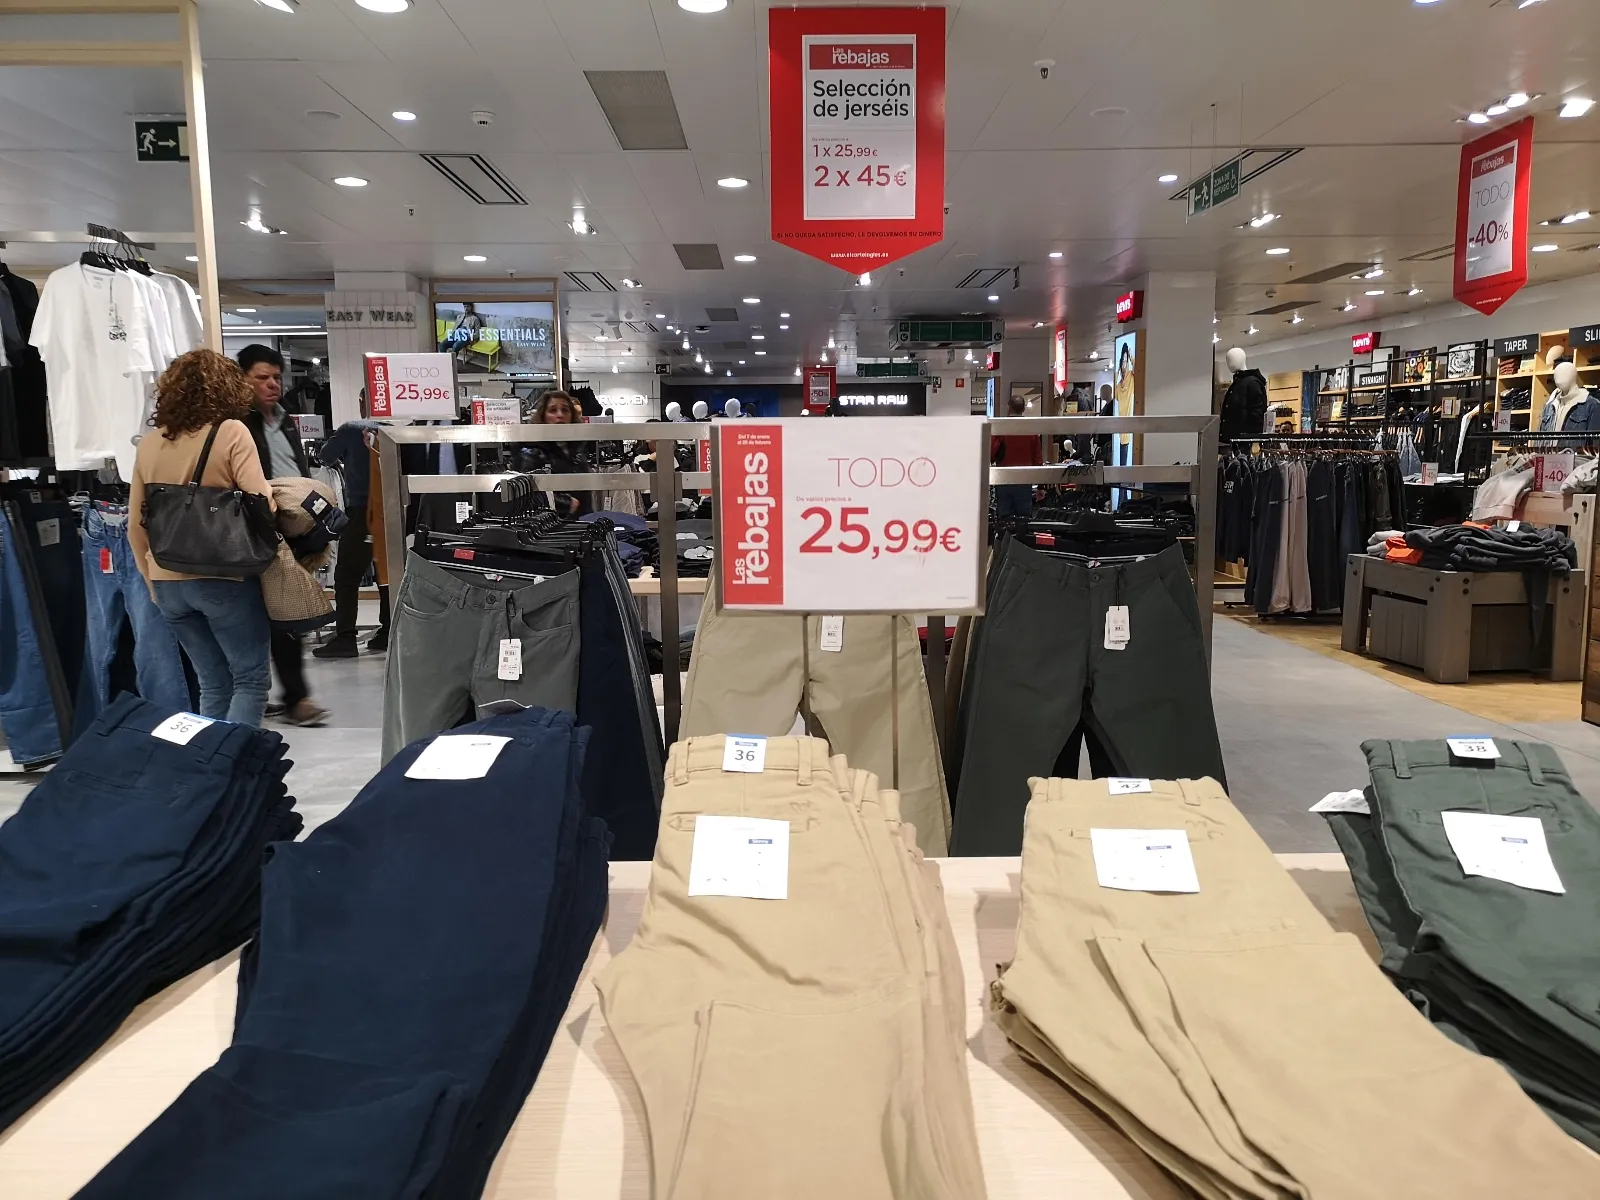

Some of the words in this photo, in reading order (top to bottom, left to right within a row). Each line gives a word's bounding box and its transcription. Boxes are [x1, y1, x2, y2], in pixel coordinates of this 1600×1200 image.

[832, 49, 889, 67] rebajas
[813, 78, 910, 97] Selección
[813, 99, 839, 117] de
[844, 98, 909, 120] jerséis
[813, 144, 819, 157] 1
[823, 147, 831, 157] x
[834, 144, 878, 159] 25,99€
[814, 165, 829, 187] 2
[836, 170, 850, 187] x
[857, 165, 907, 187] 45€
[1474, 181, 1510, 209] TODO
[1468, 220, 1509, 246] -40%
[447, 328, 475, 342] EASY
[479, 328, 546, 342] ESSENTIALS
[1585, 328, 1600, 341] SLI
[1504, 339, 1528, 352] TAPER
[404, 367, 440, 378] TODO
[1361, 374, 1385, 385] STRAIGHT
[373, 365, 387, 411] rebajas
[395, 384, 450, 402] 25,99€
[838, 395, 875, 406] STAR
[877, 394, 908, 405] RAW
[828, 457, 937, 488] TODO
[737, 452, 776, 585] rebajas
[799, 506, 961, 560] 25,99€
[732, 558, 746, 585] Las
[170, 721, 193, 733] 36
[734, 749, 756, 762] 36
[1463, 744, 1487, 752] 38
